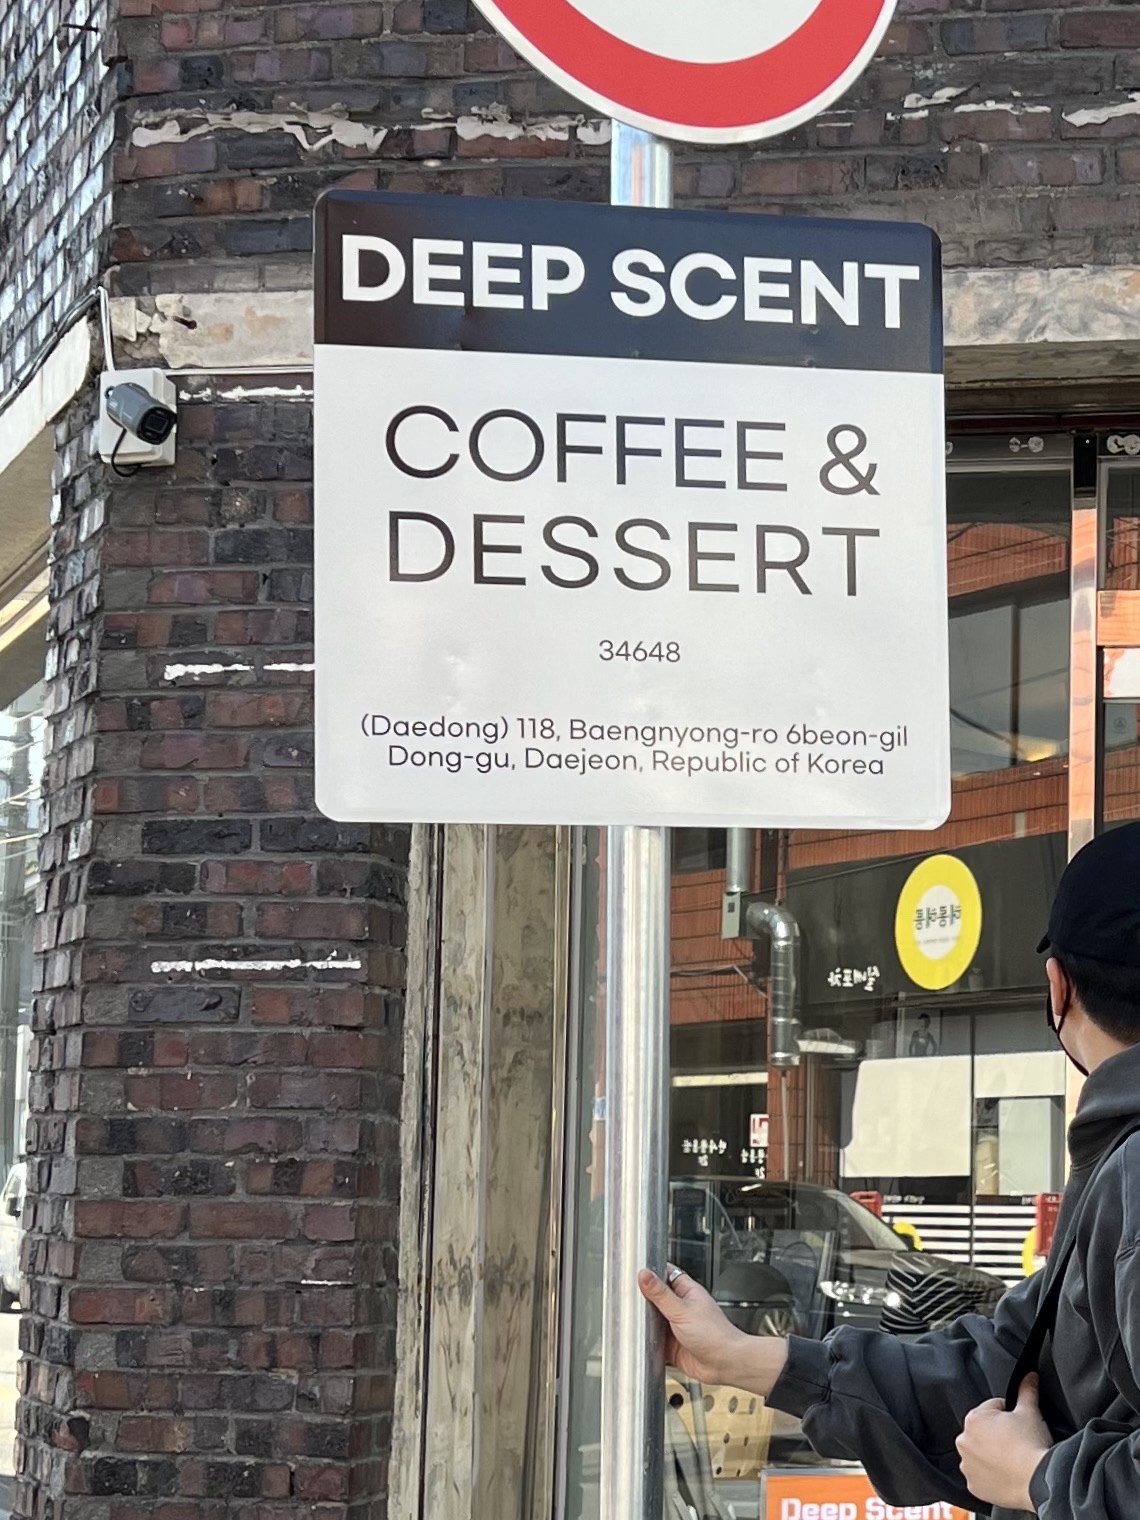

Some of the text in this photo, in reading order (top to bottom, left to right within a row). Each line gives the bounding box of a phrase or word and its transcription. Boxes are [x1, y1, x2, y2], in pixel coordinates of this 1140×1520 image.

[342, 234, 920, 329] DEEP SCENT
[385, 405, 881, 496] COFFEE &
[388, 510, 880, 597] DESSERT
[599, 639, 681, 663] 34648
[361, 713, 908, 752] (Daedong) 118, Baengnyong-ro 6beon-gil
[388, 745, 884, 777] Dong-gu, Daejeon, Republic of Korea
